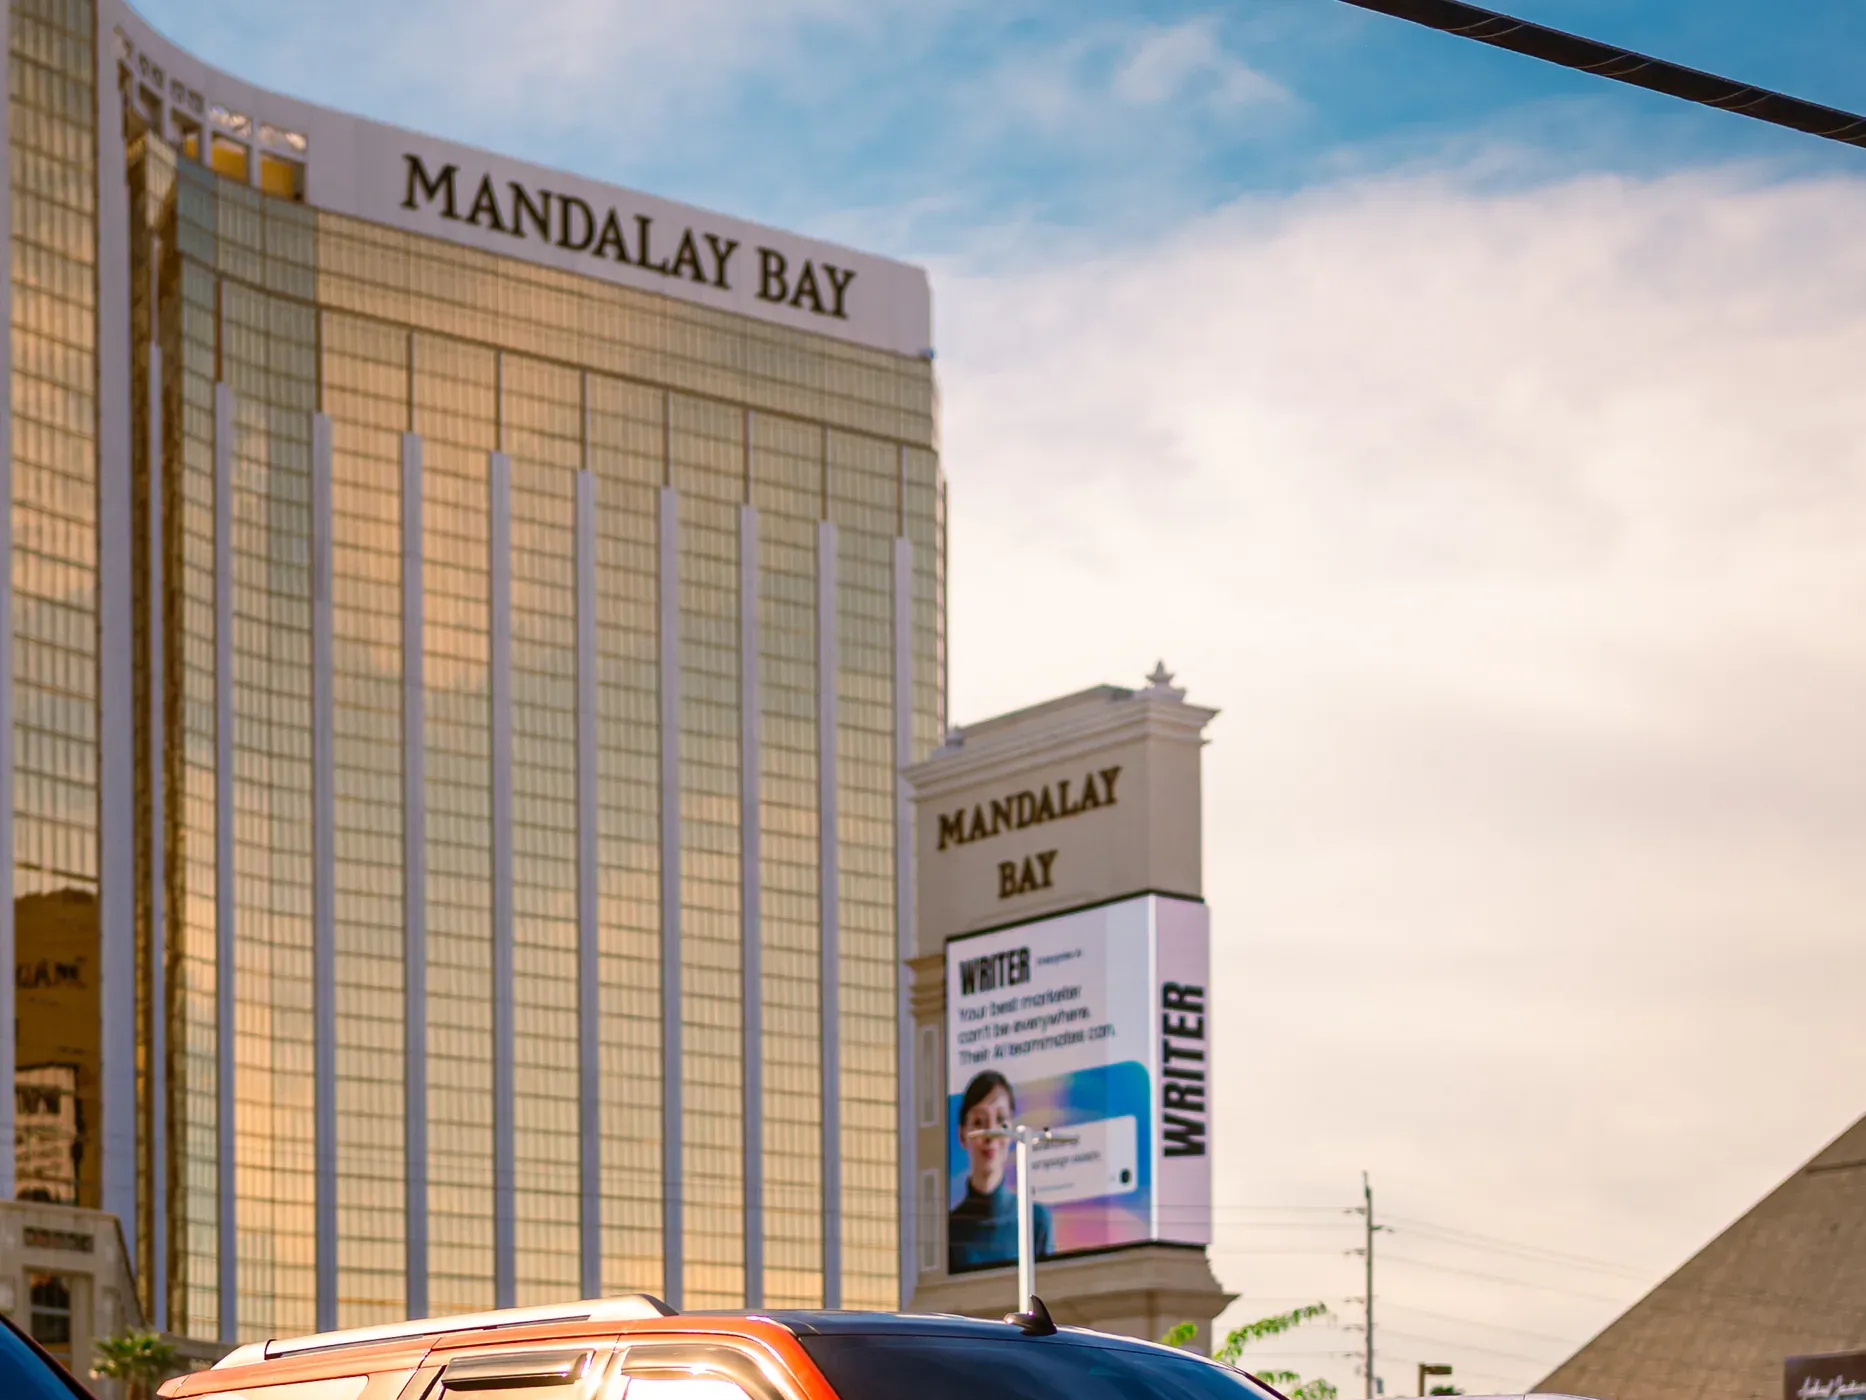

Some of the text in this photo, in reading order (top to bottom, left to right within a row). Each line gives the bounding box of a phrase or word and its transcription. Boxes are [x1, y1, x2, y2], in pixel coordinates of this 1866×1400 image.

[401, 154, 857, 319] MANDALAY BAY
[937, 765, 1122, 851] MANDALAY
[997, 850, 1058, 900] BAY
[959, 946, 1030, 996] WRITER
[1161, 980, 1206, 1159] WRITER
